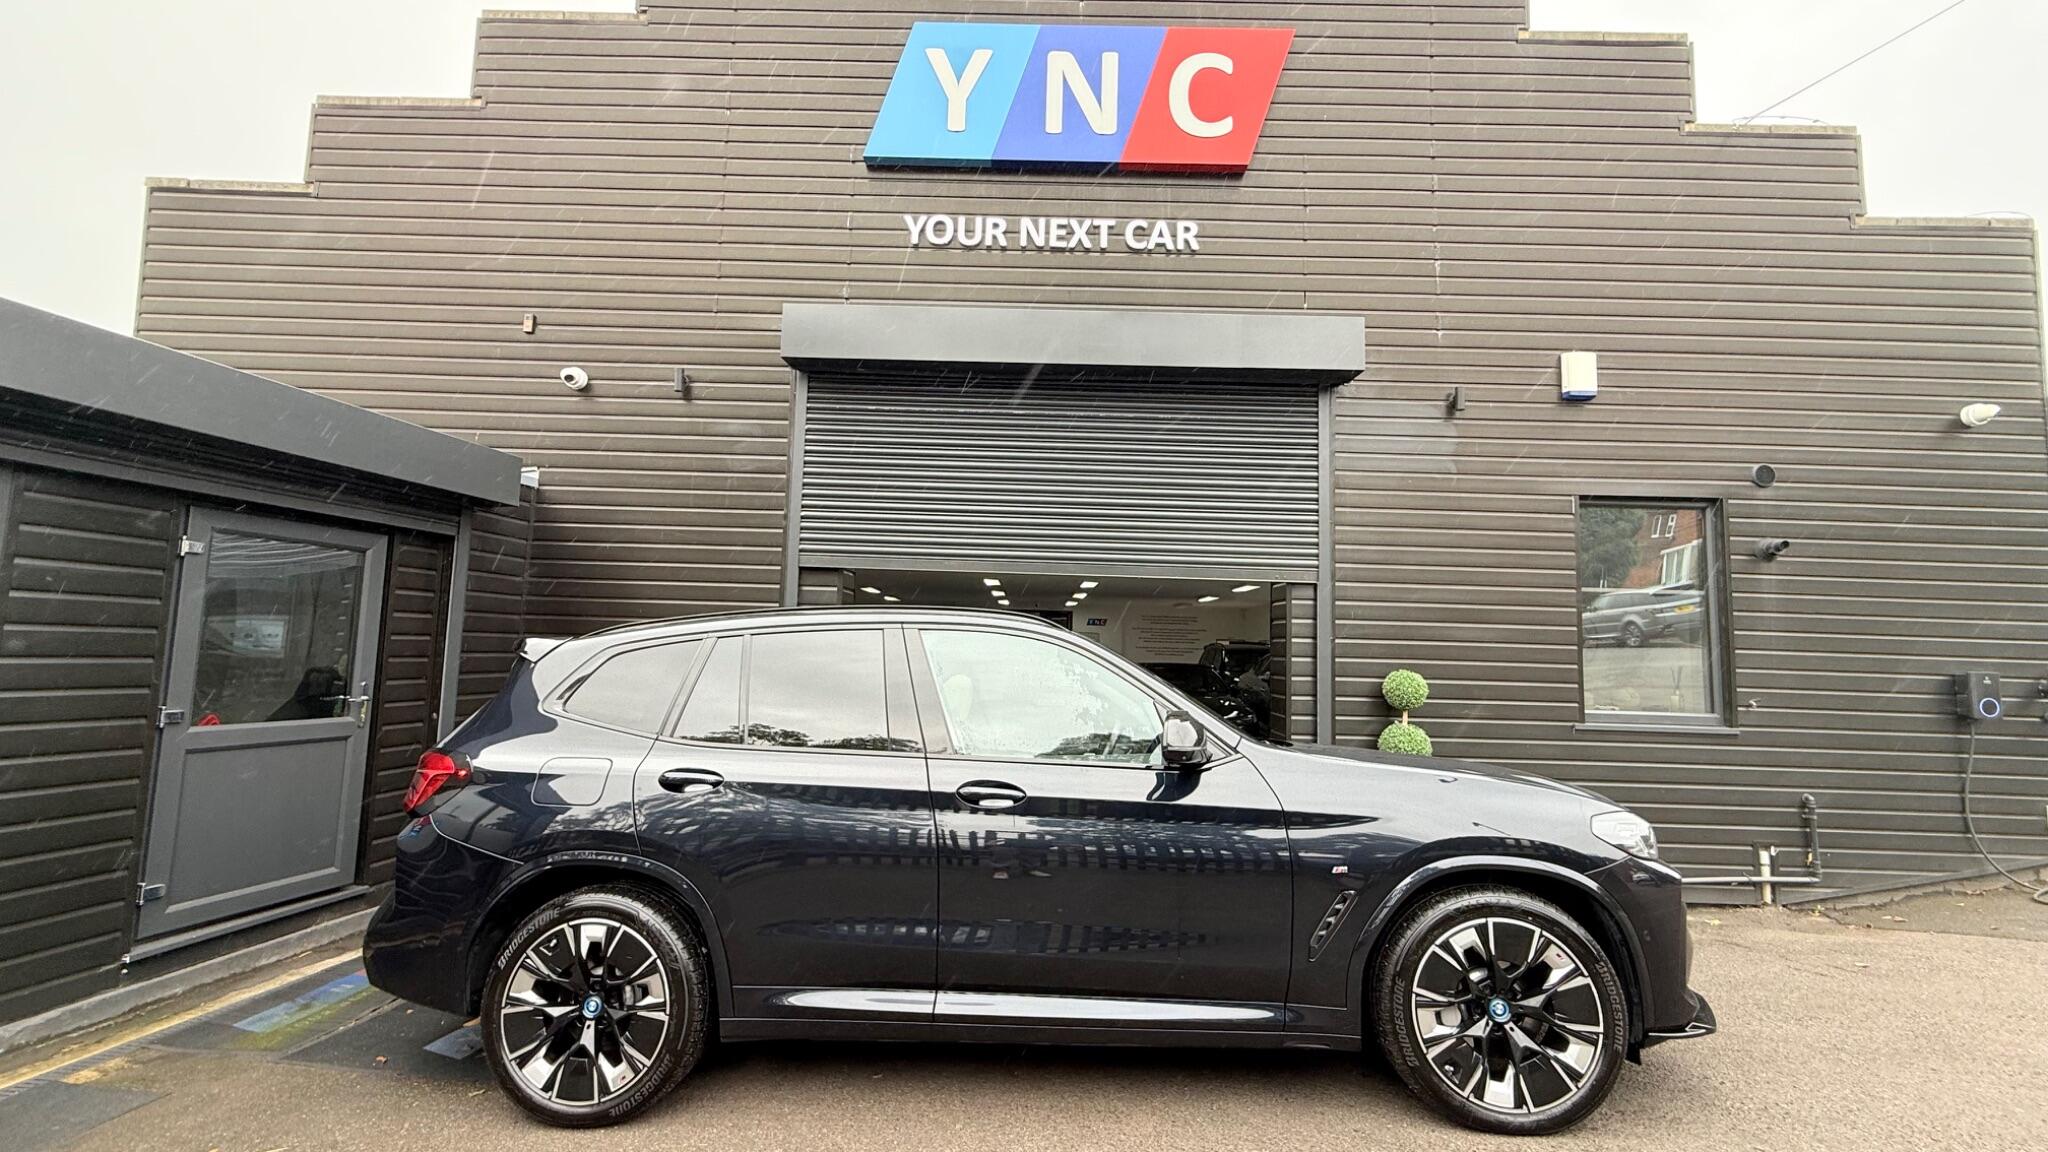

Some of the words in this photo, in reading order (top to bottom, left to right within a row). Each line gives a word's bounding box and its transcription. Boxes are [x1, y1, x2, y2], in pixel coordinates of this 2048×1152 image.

[925, 48, 1234, 138] YNC
[903, 214, 1007, 247] YOUR
[1019, 217, 1115, 250] NEXT
[1124, 219, 1200, 251] CAR
[498, 907, 560, 970] BRIDGESTONE
[1393, 977, 1420, 1068] BRIDGESTONE
[1595, 961, 1622, 1052] BRIDGESTONE
